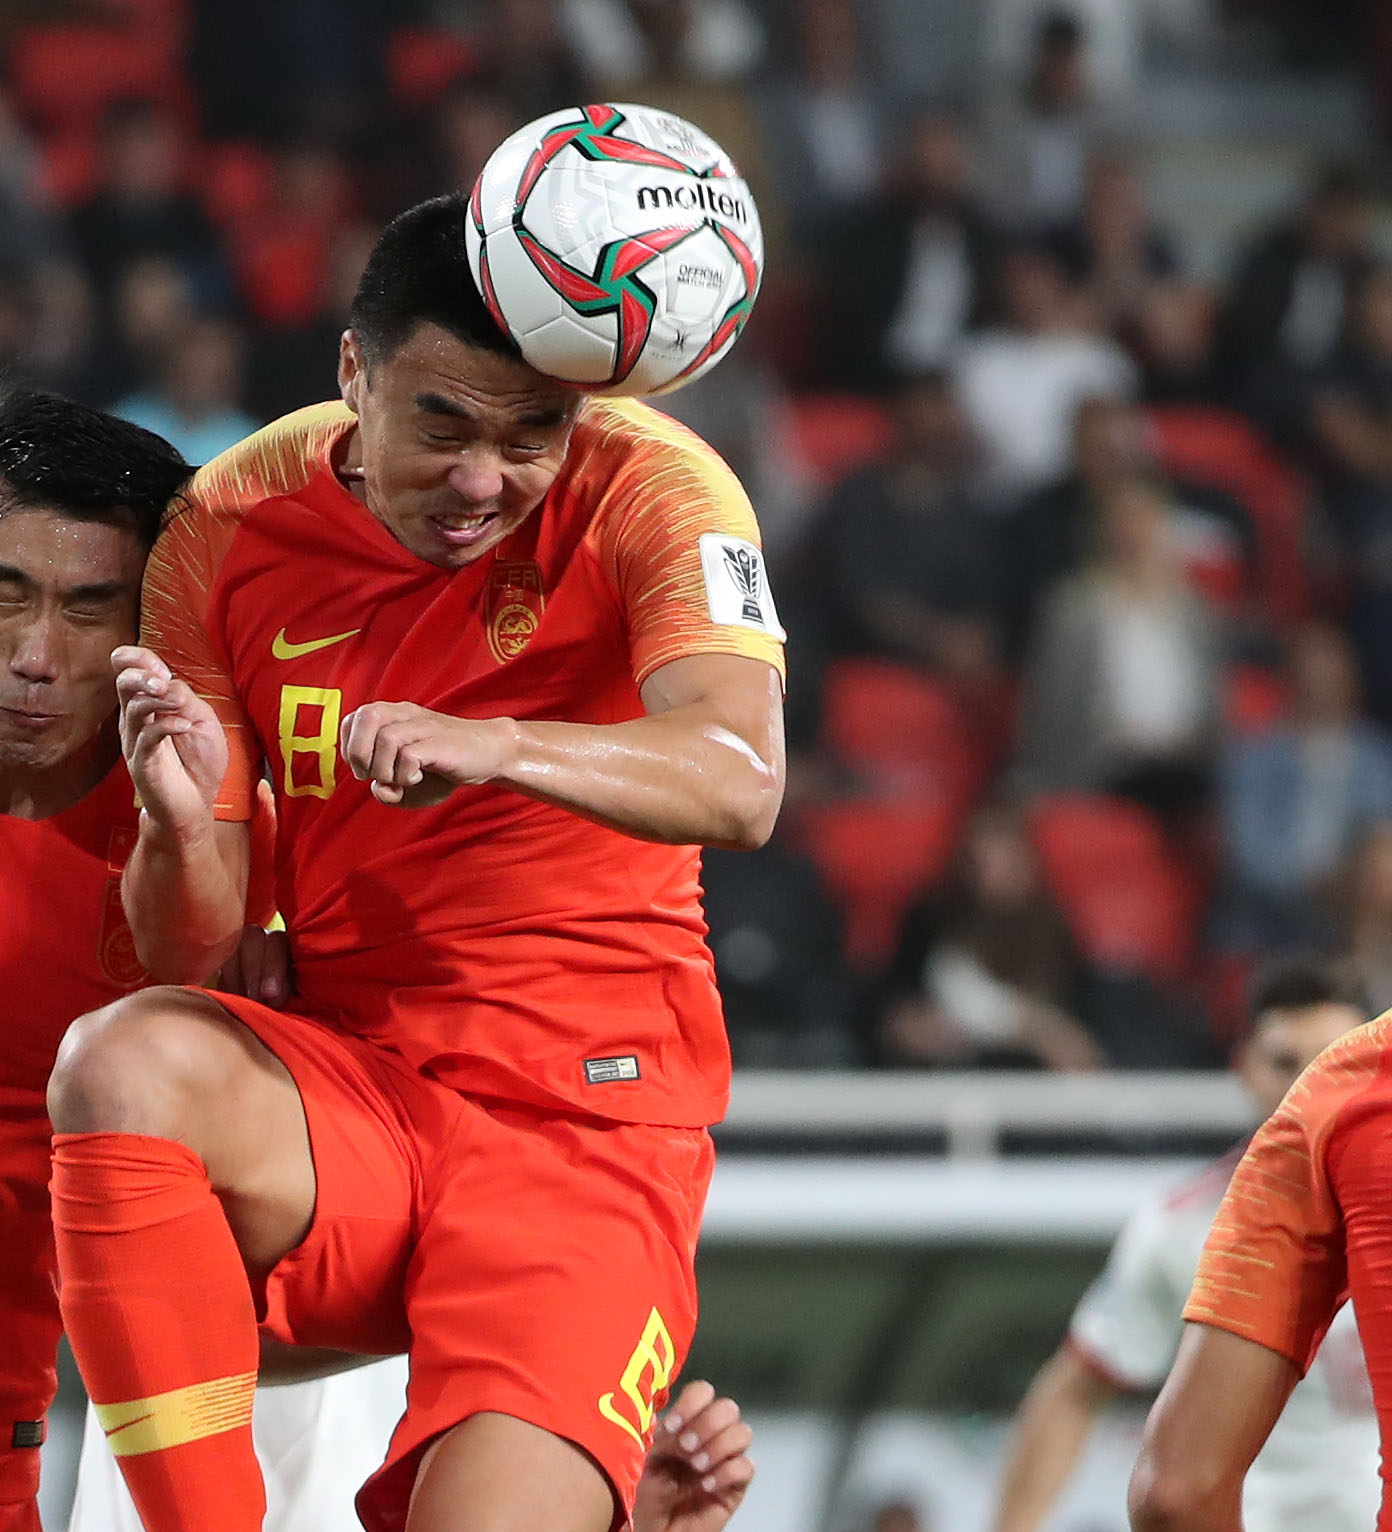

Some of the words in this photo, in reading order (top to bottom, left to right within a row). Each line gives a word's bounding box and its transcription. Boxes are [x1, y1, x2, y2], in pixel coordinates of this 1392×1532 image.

[637, 182, 747, 224] molten
[679, 265, 723, 282] OFFICIAL
[278, 684, 342, 800] 8
